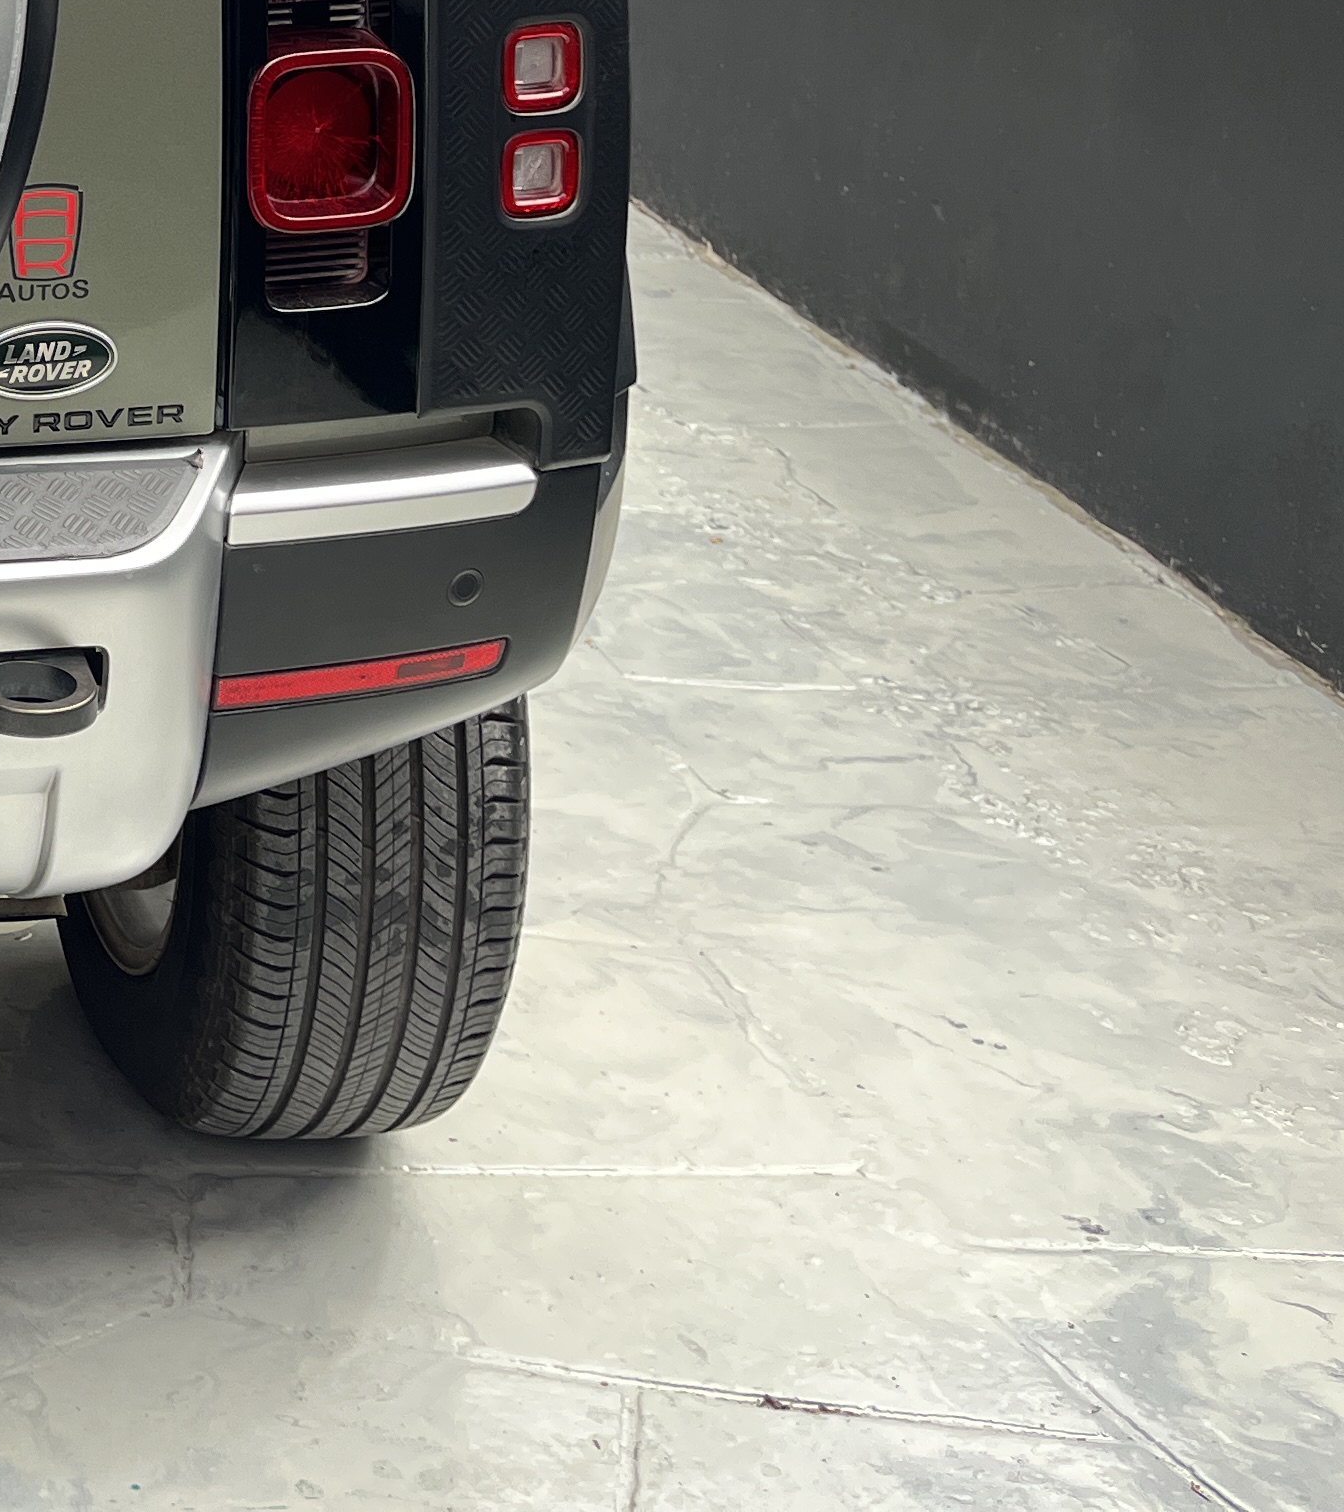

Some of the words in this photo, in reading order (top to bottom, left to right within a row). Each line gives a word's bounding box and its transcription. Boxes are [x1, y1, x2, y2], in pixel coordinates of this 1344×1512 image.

[3, 340, 72, 366] LAND
[8, 359, 93, 385] ROVER
[32, 403, 185, 434] ROVER
